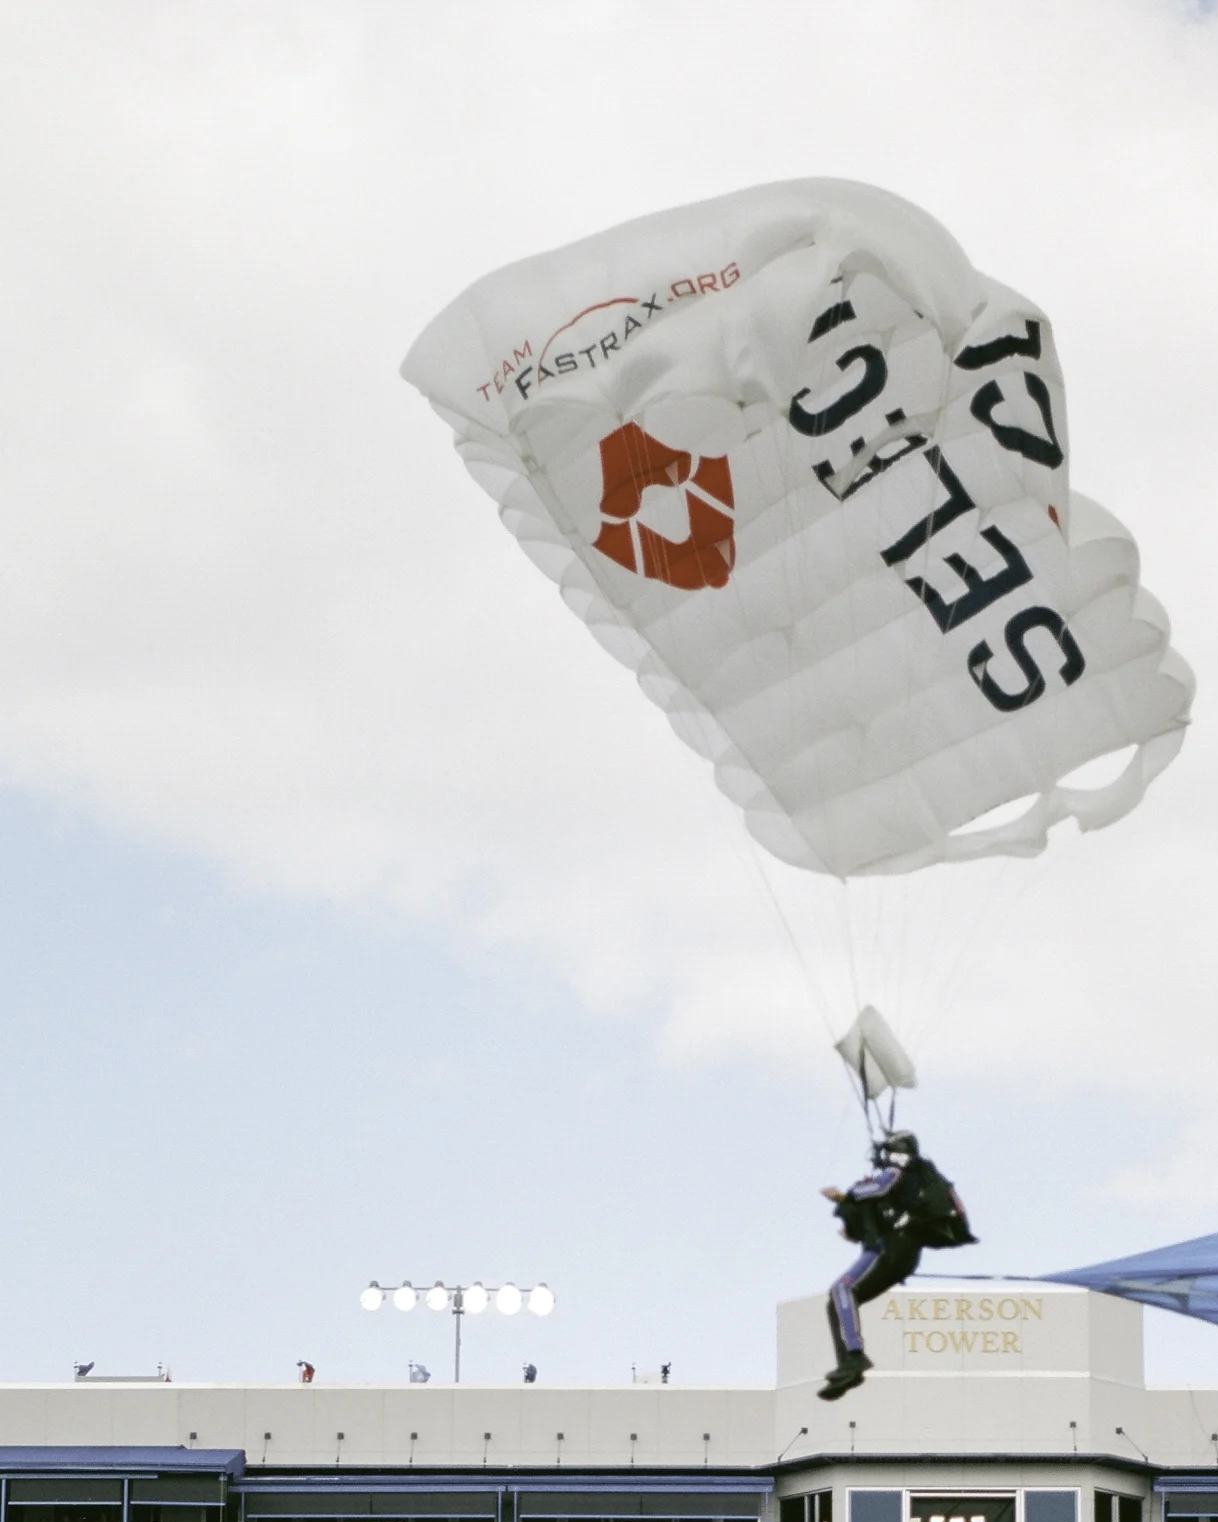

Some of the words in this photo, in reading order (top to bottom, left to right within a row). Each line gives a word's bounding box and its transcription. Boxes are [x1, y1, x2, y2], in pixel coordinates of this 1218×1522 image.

[515, 261, 741, 400] FASTRAX.ORG
[476, 340, 533, 402] TEAM
[881, 1298, 1044, 1321] AKERSON
[903, 1330, 1022, 1353] TOWER
